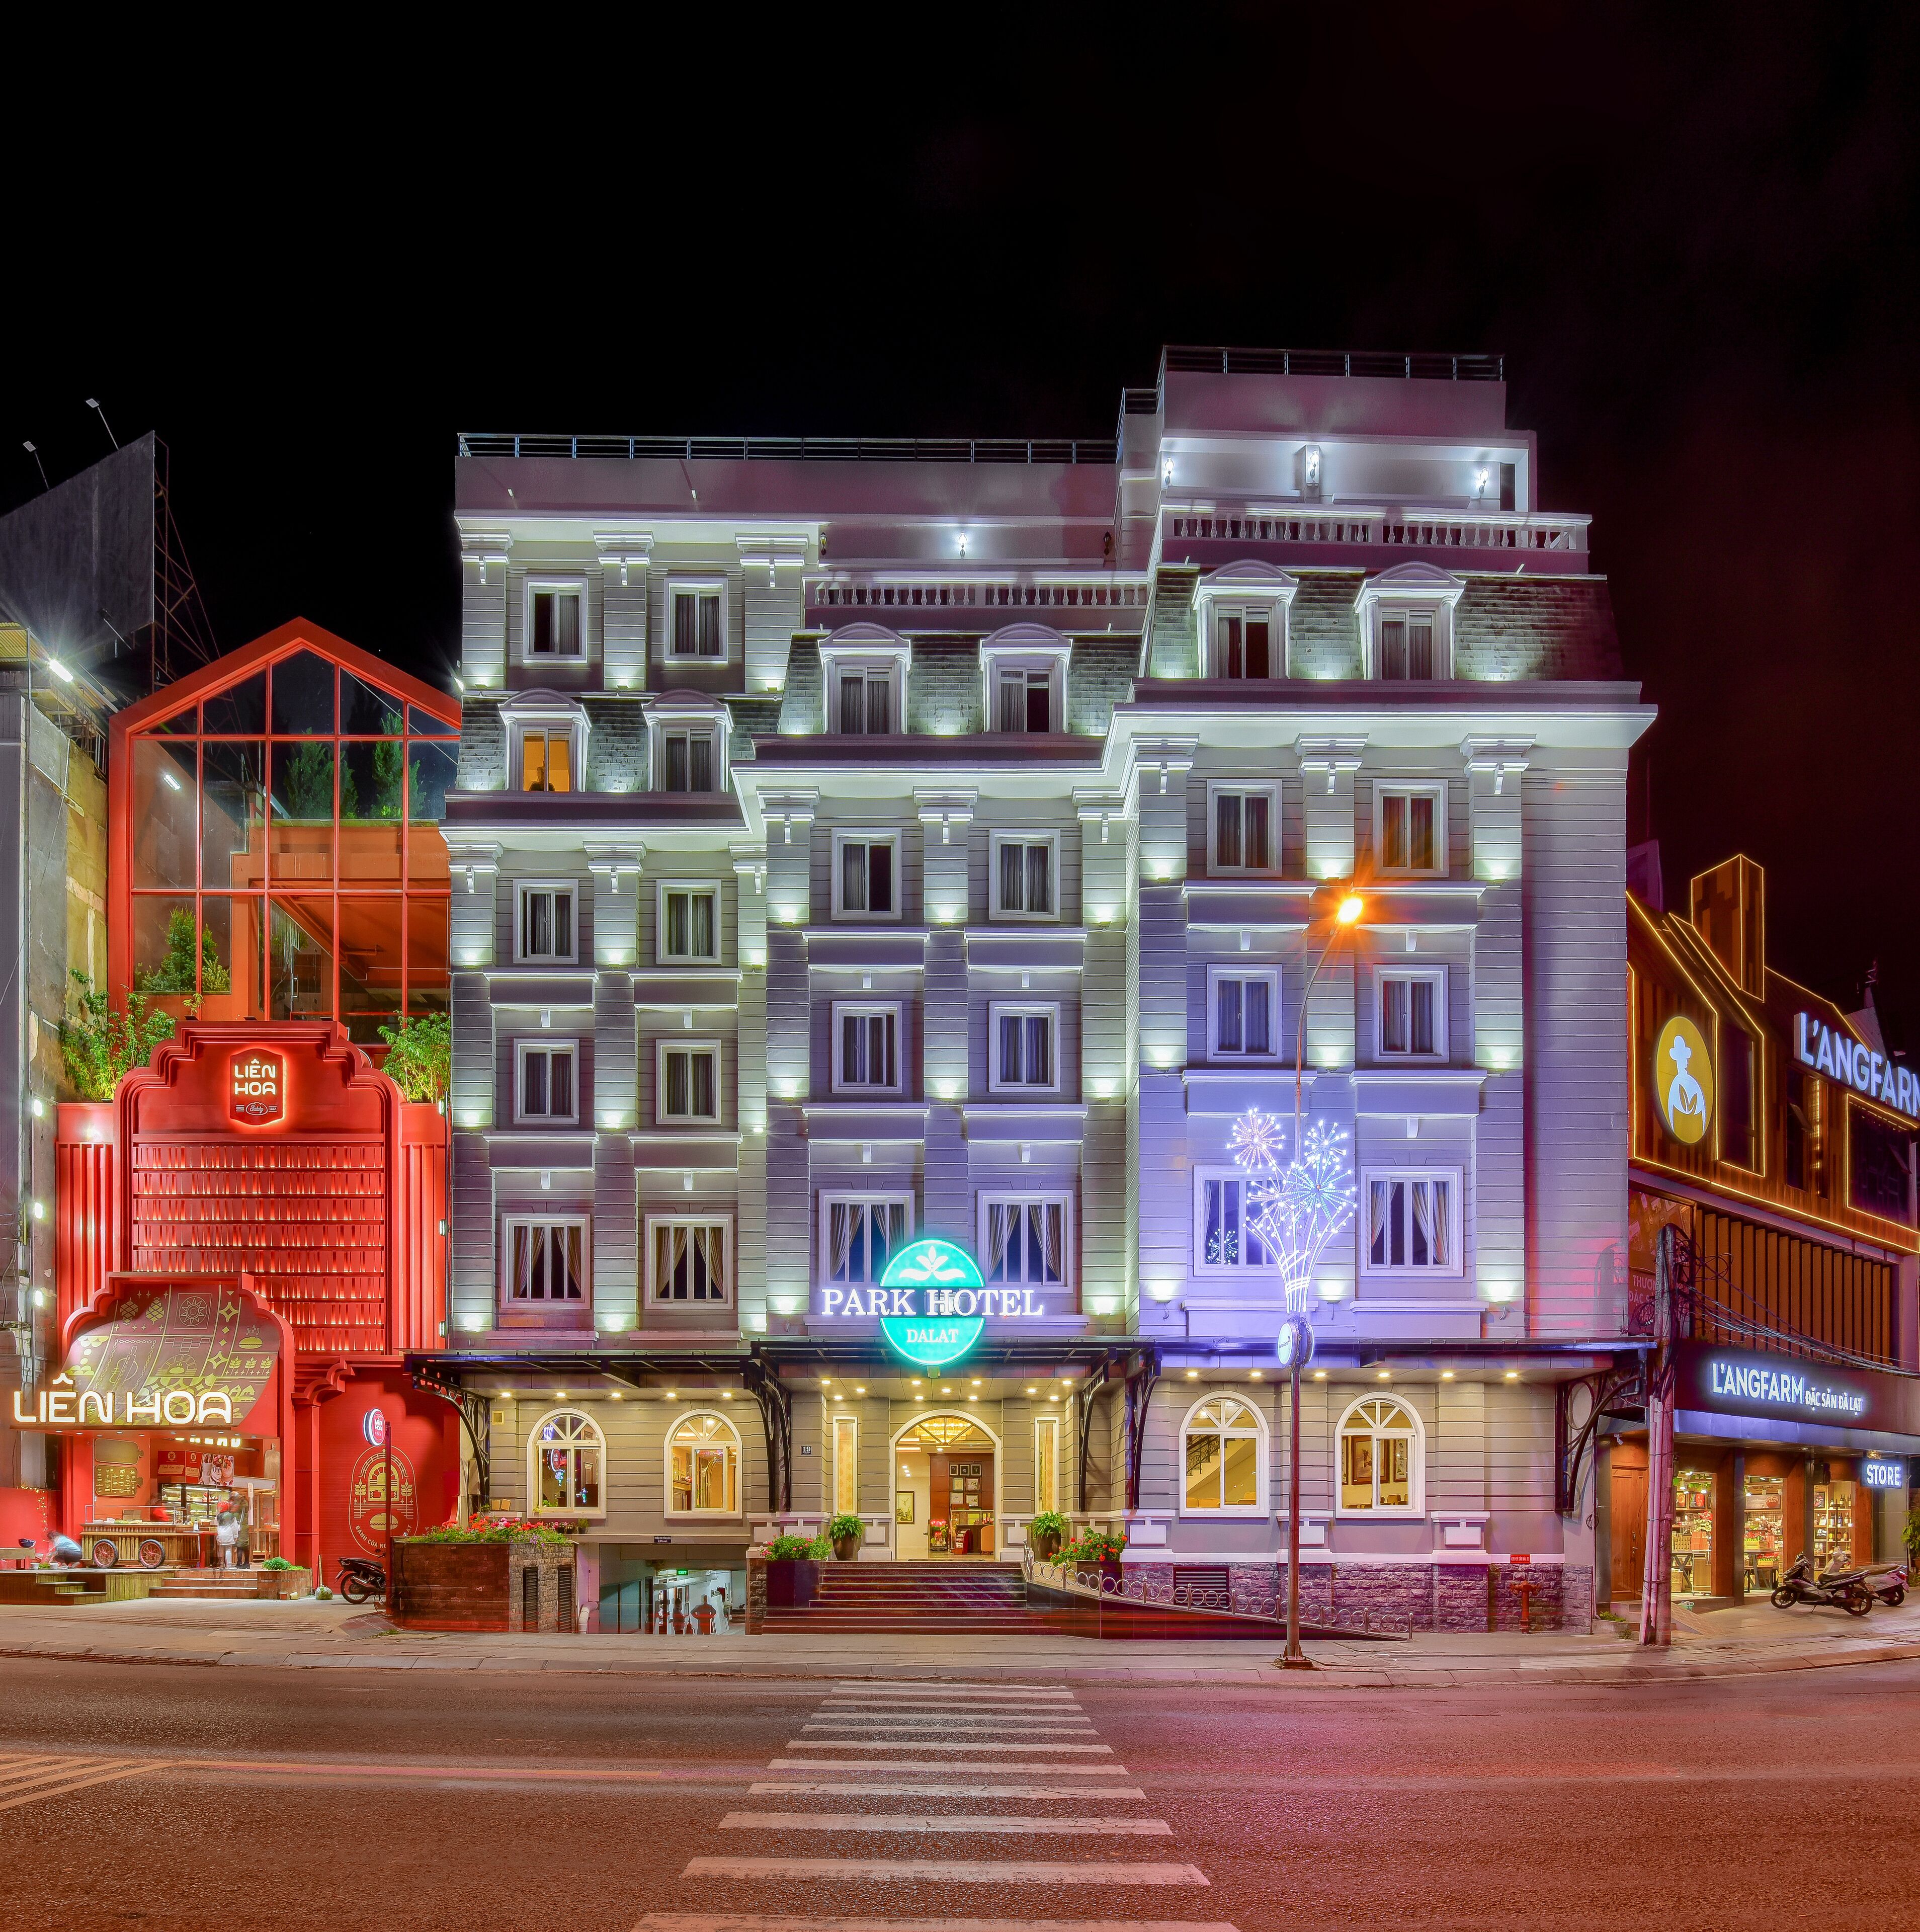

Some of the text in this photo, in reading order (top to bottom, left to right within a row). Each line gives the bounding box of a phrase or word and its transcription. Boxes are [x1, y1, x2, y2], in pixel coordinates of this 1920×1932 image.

[234, 1058, 276, 1078] LIÊN
[234, 1082, 276, 1095] HOA
[821, 1289, 1043, 1316] PARK HOTEL
[906, 1329, 959, 1343] DALAT
[14, 1373, 231, 1424] LIÊN HOA
[1712, 1363, 1862, 1416] L'ANGFARM ĐẶC SẢN ĐÀ LẠT
[1867, 1464, 1900, 1486] STORE
[355, 1525, 367, 1541] BÁNH
[367, 1539, 378, 1548] CỦA
